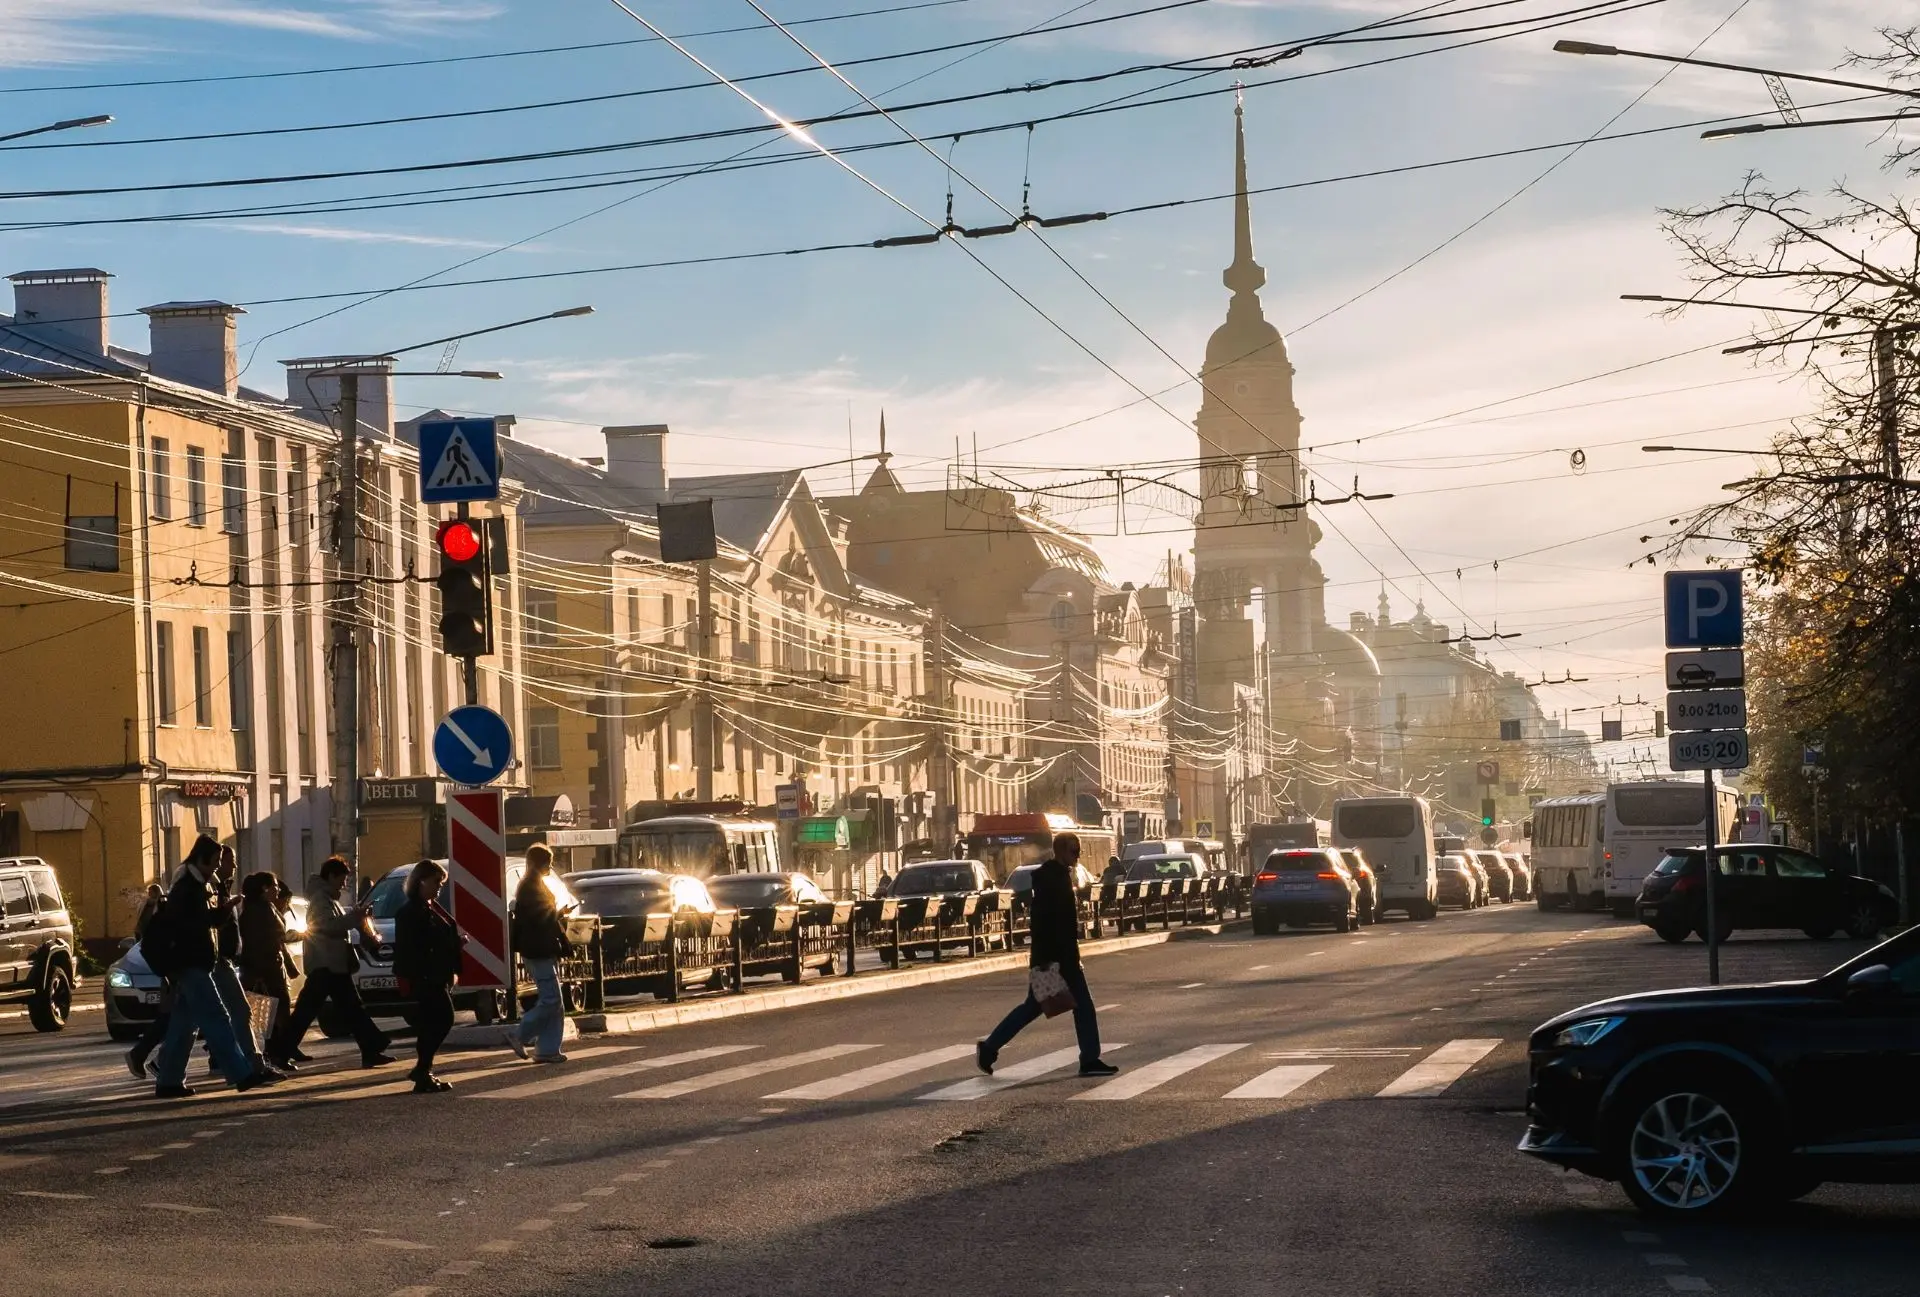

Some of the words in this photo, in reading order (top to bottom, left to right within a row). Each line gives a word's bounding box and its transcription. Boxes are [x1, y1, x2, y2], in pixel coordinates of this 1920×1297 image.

[1688, 579, 1729, 640] P
[1679, 745, 1692, 758] 10
[1694, 744, 1711, 758] 15
[1715, 740, 1739, 758] 20
[367, 783, 418, 801] ВЕТЫ
